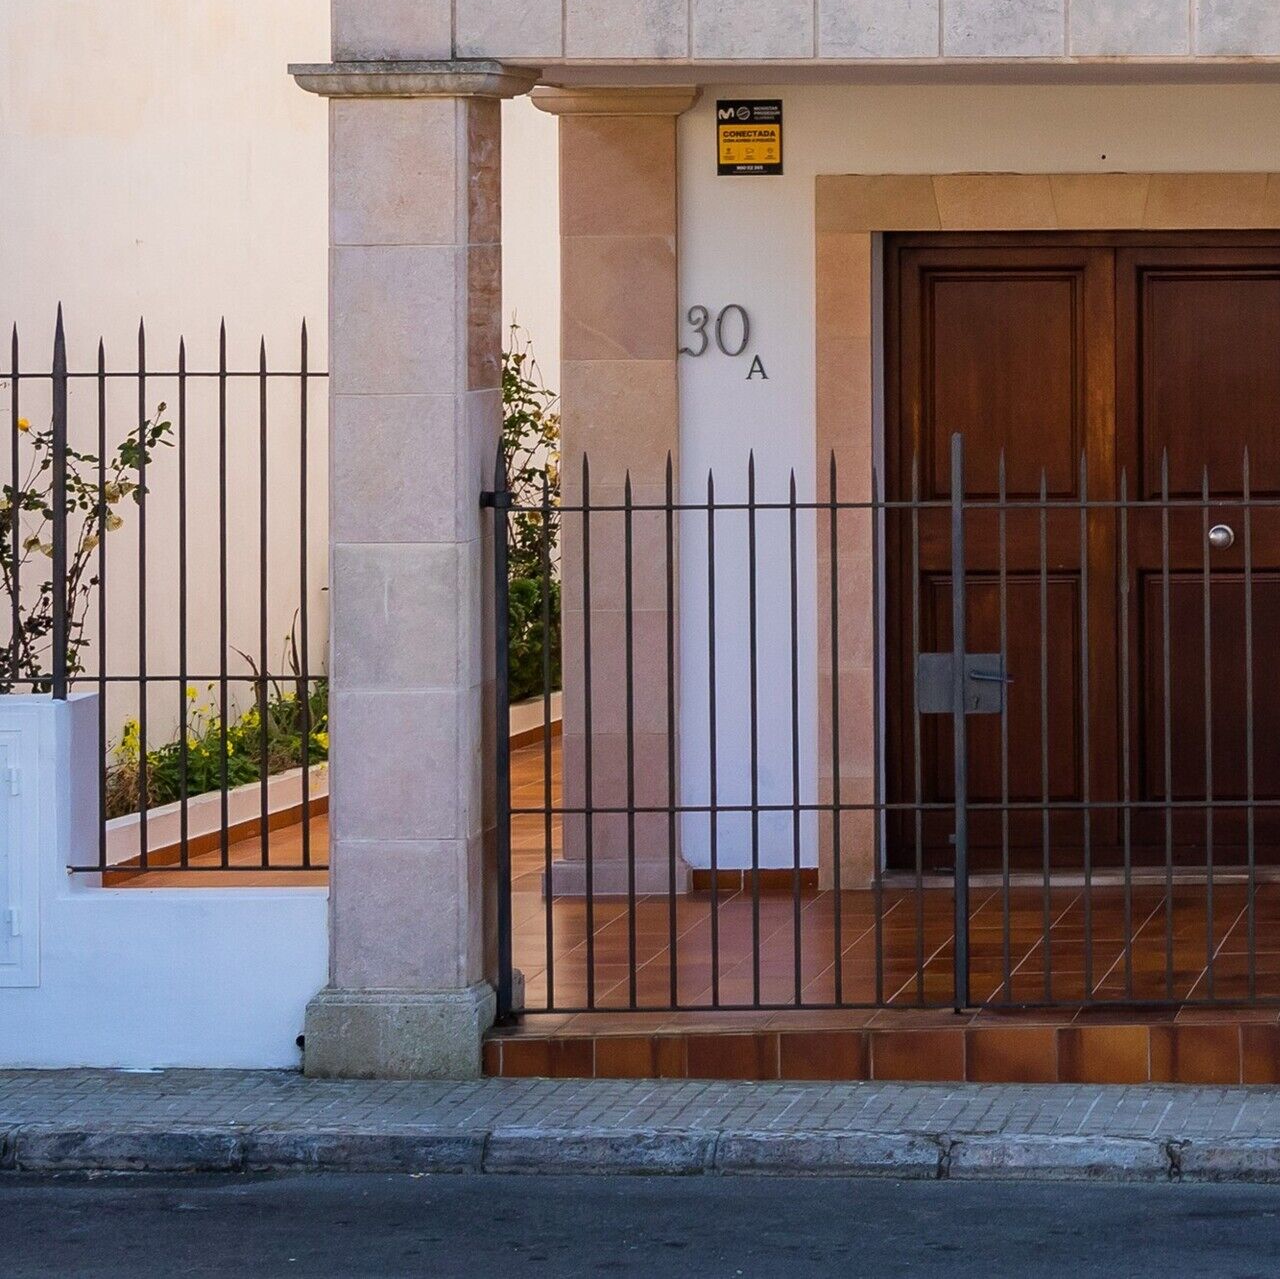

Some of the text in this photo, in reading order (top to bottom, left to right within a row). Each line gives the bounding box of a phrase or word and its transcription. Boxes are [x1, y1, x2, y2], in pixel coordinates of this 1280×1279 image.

[723, 130, 776, 138] CONECTADA
[678, 304, 770, 380] 30 A
